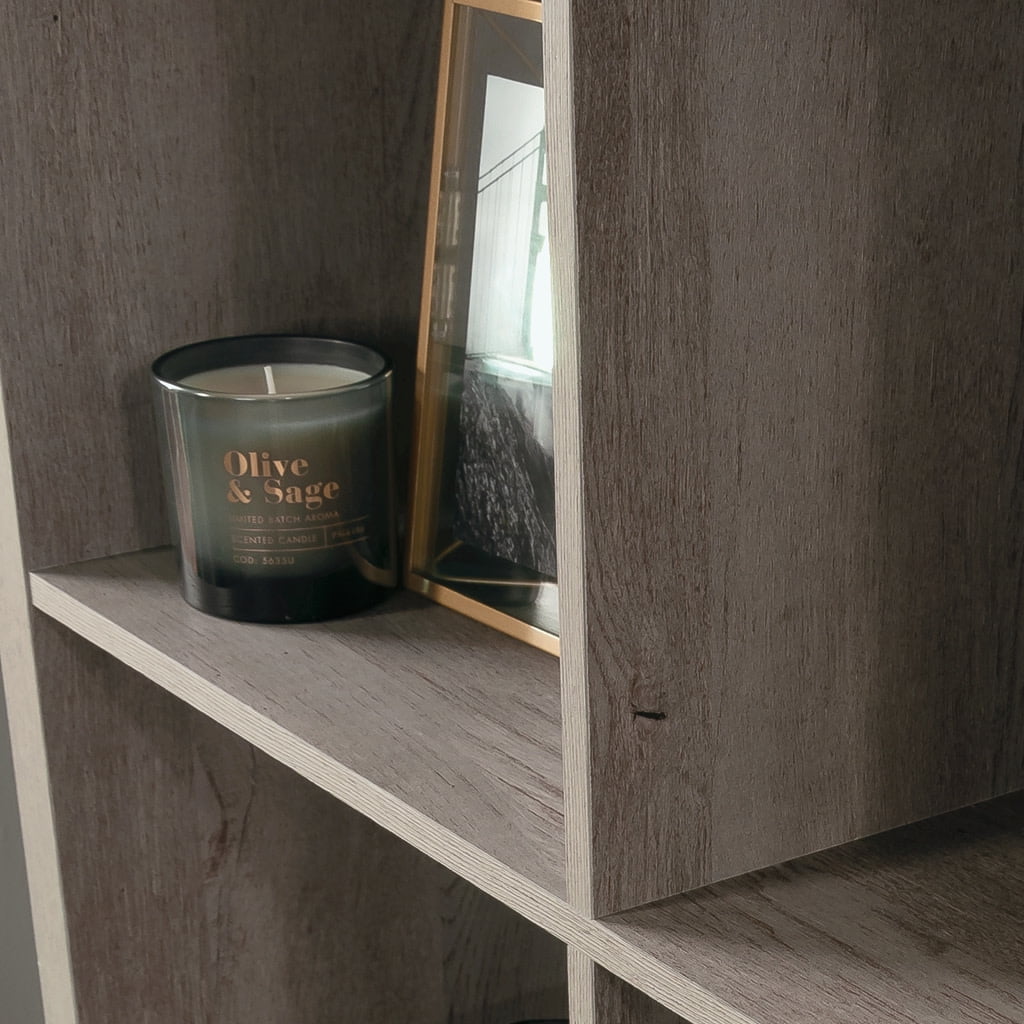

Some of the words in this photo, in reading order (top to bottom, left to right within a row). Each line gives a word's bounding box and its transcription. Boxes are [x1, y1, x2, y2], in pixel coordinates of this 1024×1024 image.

[223, 450, 309, 477] Olive
[227, 480, 251, 504] &
[264, 478, 341, 509] Sage
[278, 534, 318, 544] CANDLE
